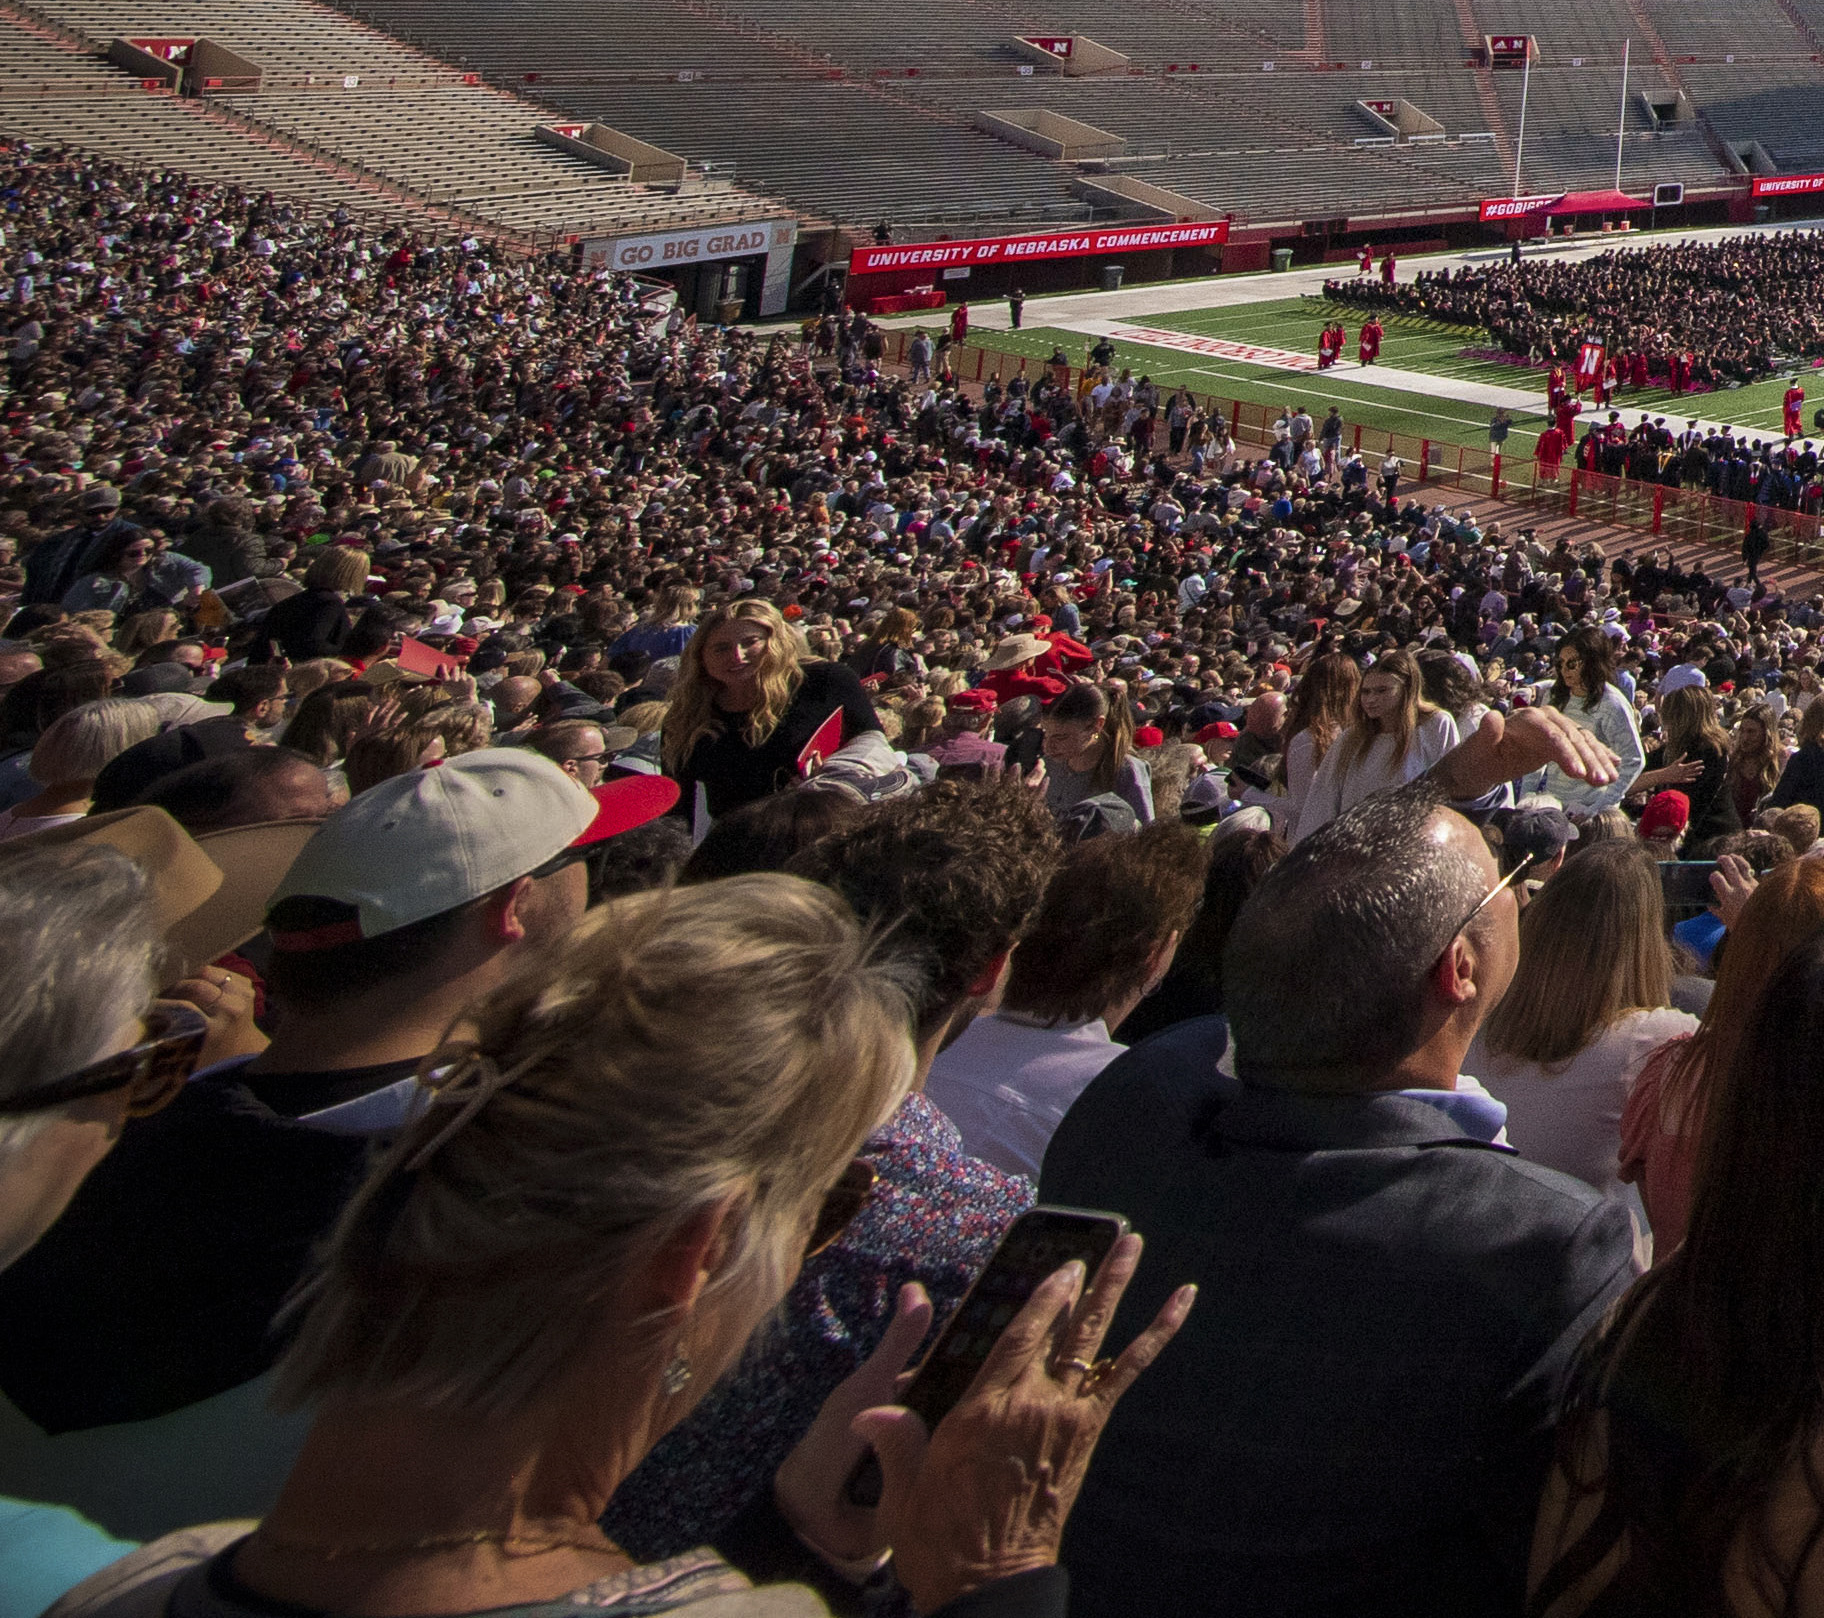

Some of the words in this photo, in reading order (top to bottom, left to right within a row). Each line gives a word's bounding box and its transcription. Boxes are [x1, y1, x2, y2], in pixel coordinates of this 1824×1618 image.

[1053, 42, 1068, 53] N
[1512, 40, 1523, 49] N
[1760, 179, 1811, 192] UNIVERSITY
[1812, 178, 1824, 187] OF
[776, 228, 789, 244] N
[620, 245, 654, 266] GO
[662, 239, 700, 260] BIG
[706, 231, 766, 254] GRAD
[868, 246, 973, 266] UNIVERSITY
[977, 244, 1000, 258] OF
[1004, 237, 1090, 255] NEBRASKA
[1096, 227, 1218, 248] COMMENCEMENT
[1580, 348, 1600, 375] N
